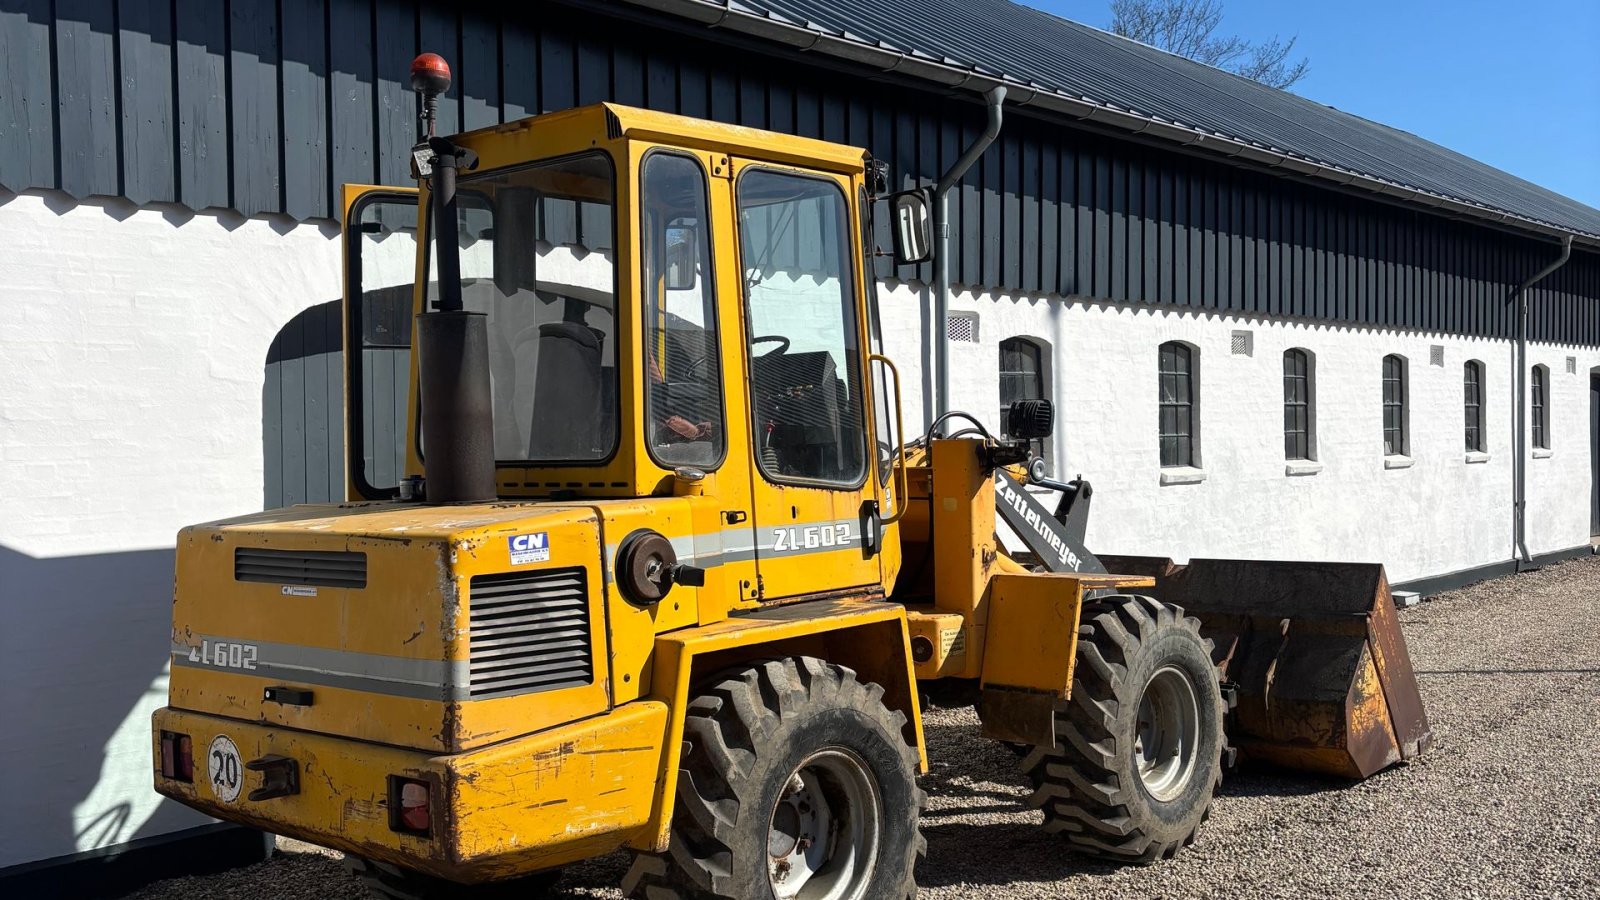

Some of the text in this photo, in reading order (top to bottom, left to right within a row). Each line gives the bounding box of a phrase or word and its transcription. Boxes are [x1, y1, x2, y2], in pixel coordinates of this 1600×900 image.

[512, 533, 544, 551] CN
[995, 473, 1082, 573] Zettelmeyer
[212, 749, 238, 788] 20
